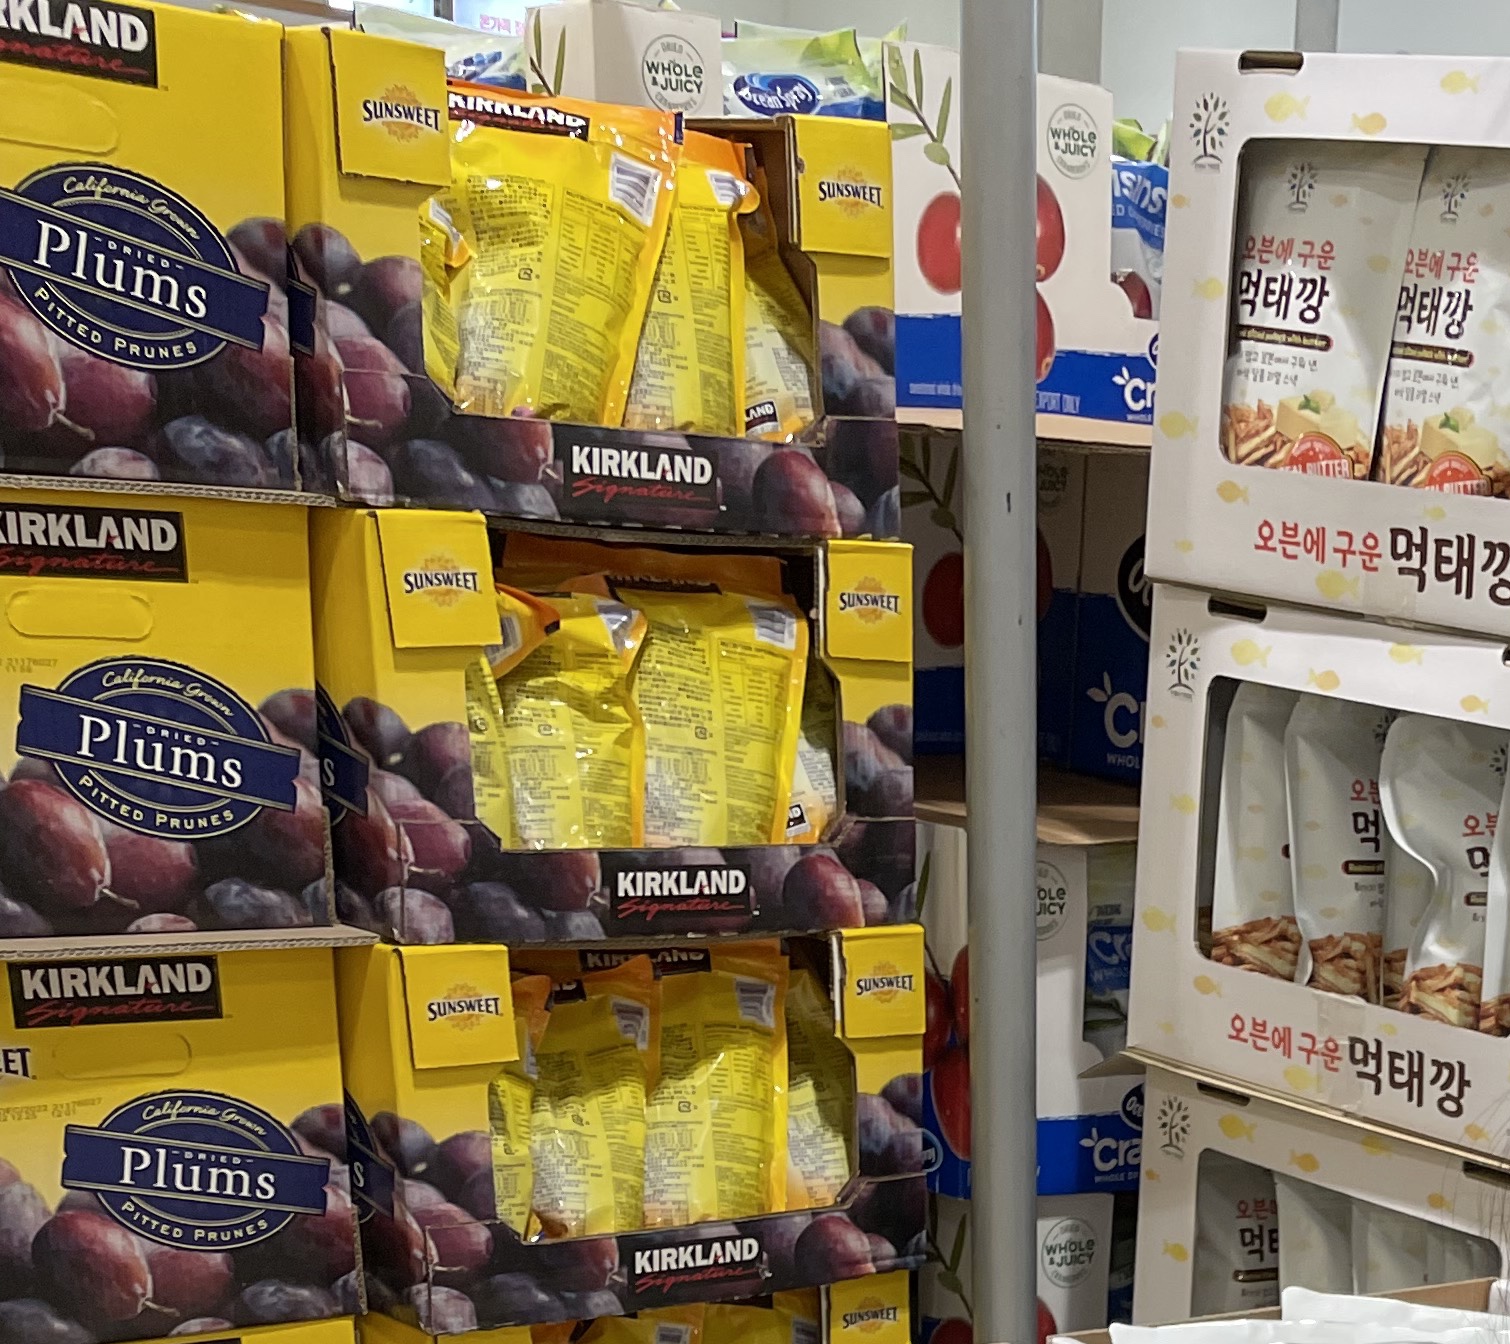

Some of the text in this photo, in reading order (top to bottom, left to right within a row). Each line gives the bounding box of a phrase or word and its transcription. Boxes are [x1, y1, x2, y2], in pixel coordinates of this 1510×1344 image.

[660, 77, 703, 94] JUICY
[362, 99, 441, 131] SUNSWEET
[448, 93, 587, 127] KIRKLAND
[63, 176, 145, 206] California
[818, 180, 883, 208] SUNSWEET
[33, 219, 208, 320] Plums
[108, 240, 171, 269] DRIED
[1243, 235, 1335, 270] 오븐에 구운
[1404, 248, 1479, 283] 오븐에 구운
[1239, 268, 1330, 324] 먹태깡
[1398, 283, 1473, 339] 먹태깡
[34, 286, 197, 359] PITTED PRUNES
[571, 445, 712, 484] KIRKLAND
[1254, 517, 1327, 564] 오븐에
[1332, 527, 1383, 572] 구운
[403, 570, 481, 594] SUNSWEET
[839, 591, 901, 613] SUNSWEET
[102, 667, 185, 691] California
[76, 713, 244, 790] Plums
[146, 725, 206, 747] DRIED
[78, 774, 235, 830] PITTED PRUNES
[617, 870, 746, 897] KIRKLAND
[21, 962, 213, 1001] KIRKLAND
[856, 974, 914, 995] SUNSWEET
[427, 995, 502, 1021] SUNSWEET
[1226, 1012, 1473, 1118] 오븐에 구운 먹태깡
[142, 1098, 220, 1121] California
[117, 1146, 277, 1202] Plums
[184, 1150, 242, 1166] DRIED
[121, 1201, 269, 1243] PITTED PRUNES
[634, 1238, 759, 1274] KIRKLAND
[842, 1306, 897, 1330] SUNSWEET
